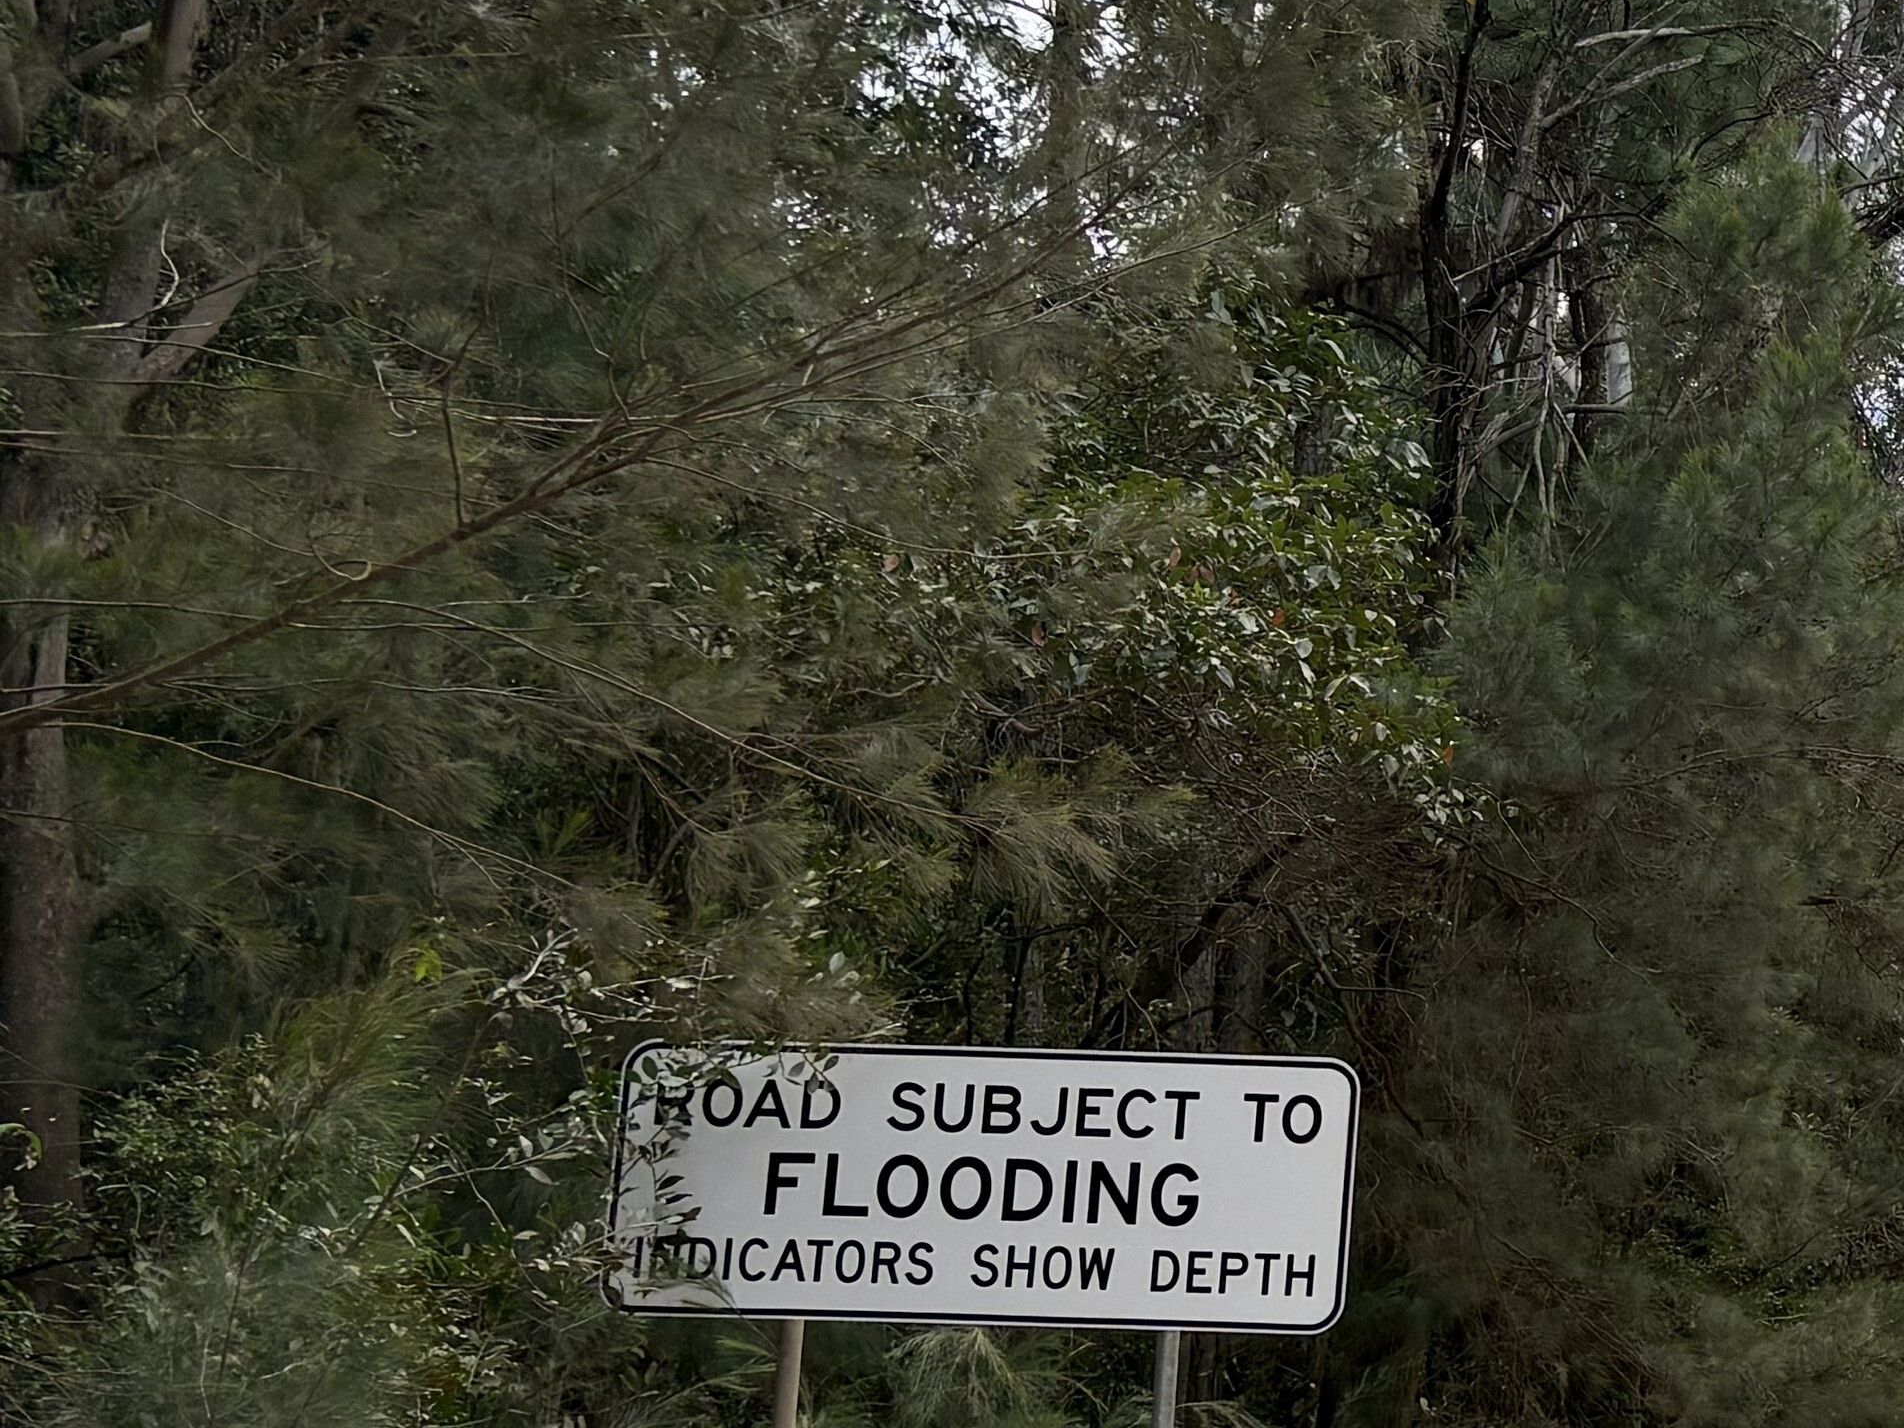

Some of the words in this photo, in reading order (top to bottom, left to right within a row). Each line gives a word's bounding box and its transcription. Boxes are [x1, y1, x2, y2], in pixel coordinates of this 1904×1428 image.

[886, 1082, 1200, 1140] SUBJECT
[1243, 1093, 1323, 1145] TO
[763, 1152, 1200, 1227] FLOODING
[970, 1243, 1115, 1291] SHOW
[1149, 1250, 1317, 1297] DEPTH
